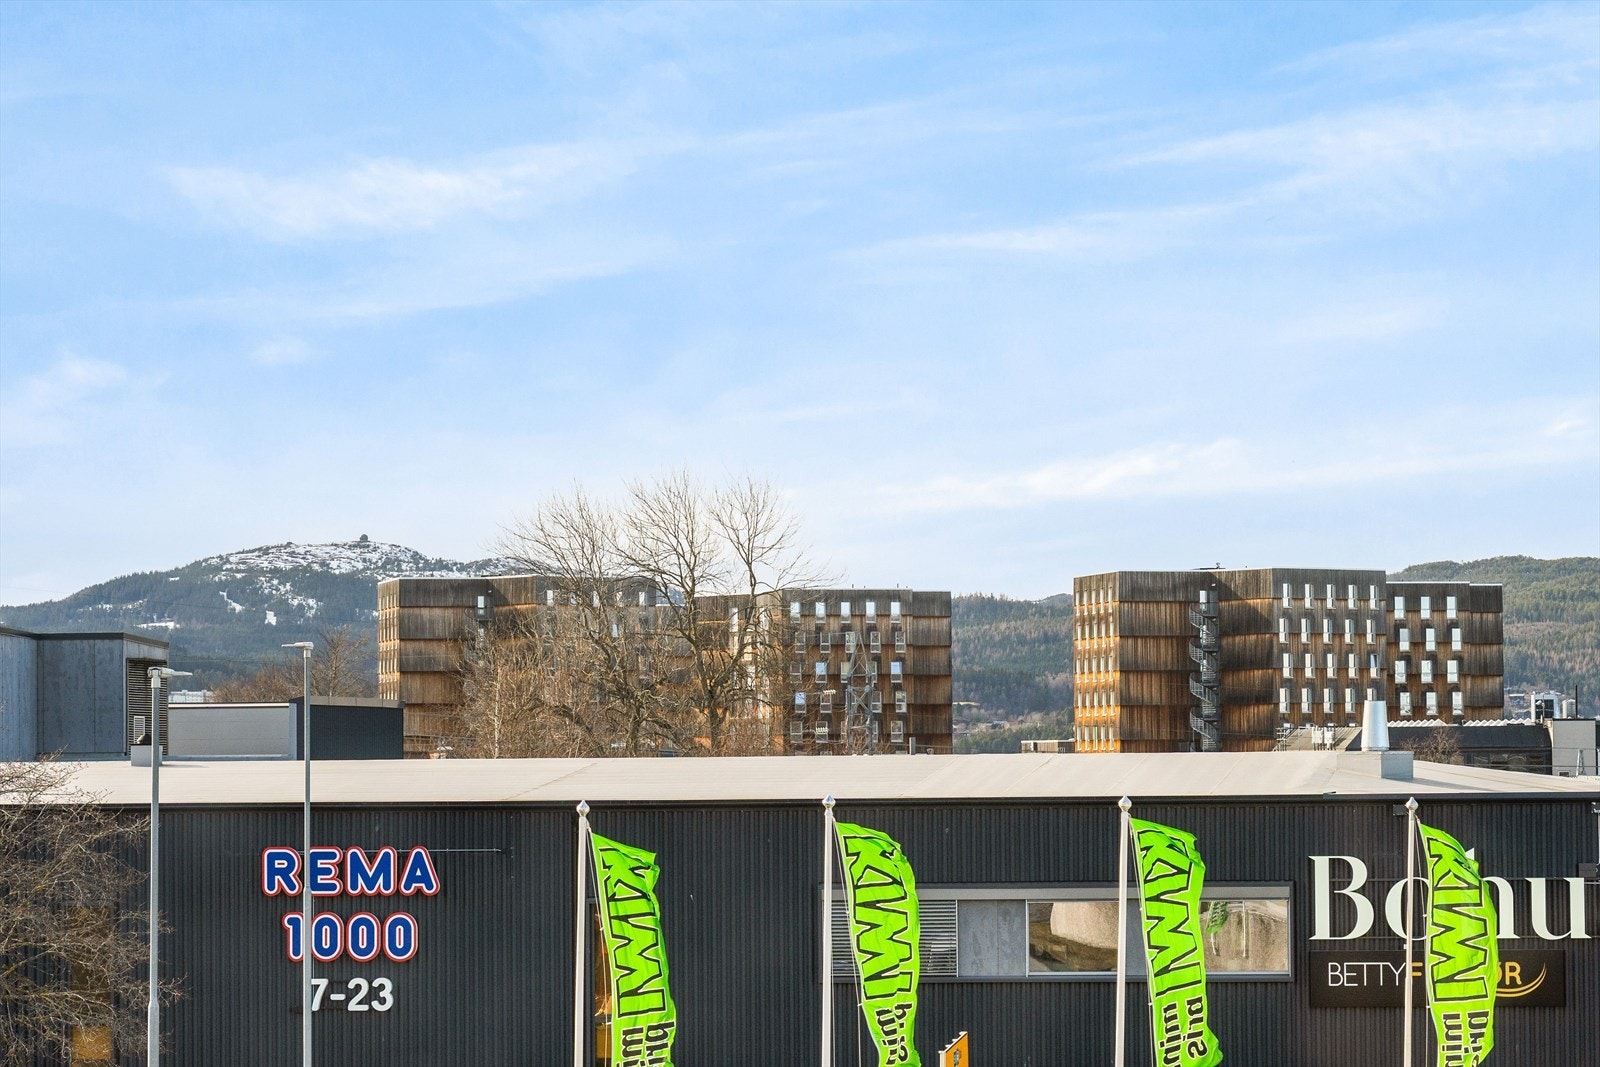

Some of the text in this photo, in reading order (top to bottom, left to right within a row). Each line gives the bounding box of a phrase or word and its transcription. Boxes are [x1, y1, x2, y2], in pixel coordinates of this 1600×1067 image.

[262, 846, 440, 896] REMA
[282, 911, 418, 962] 1000
[311, 977, 394, 1012] 7-23
